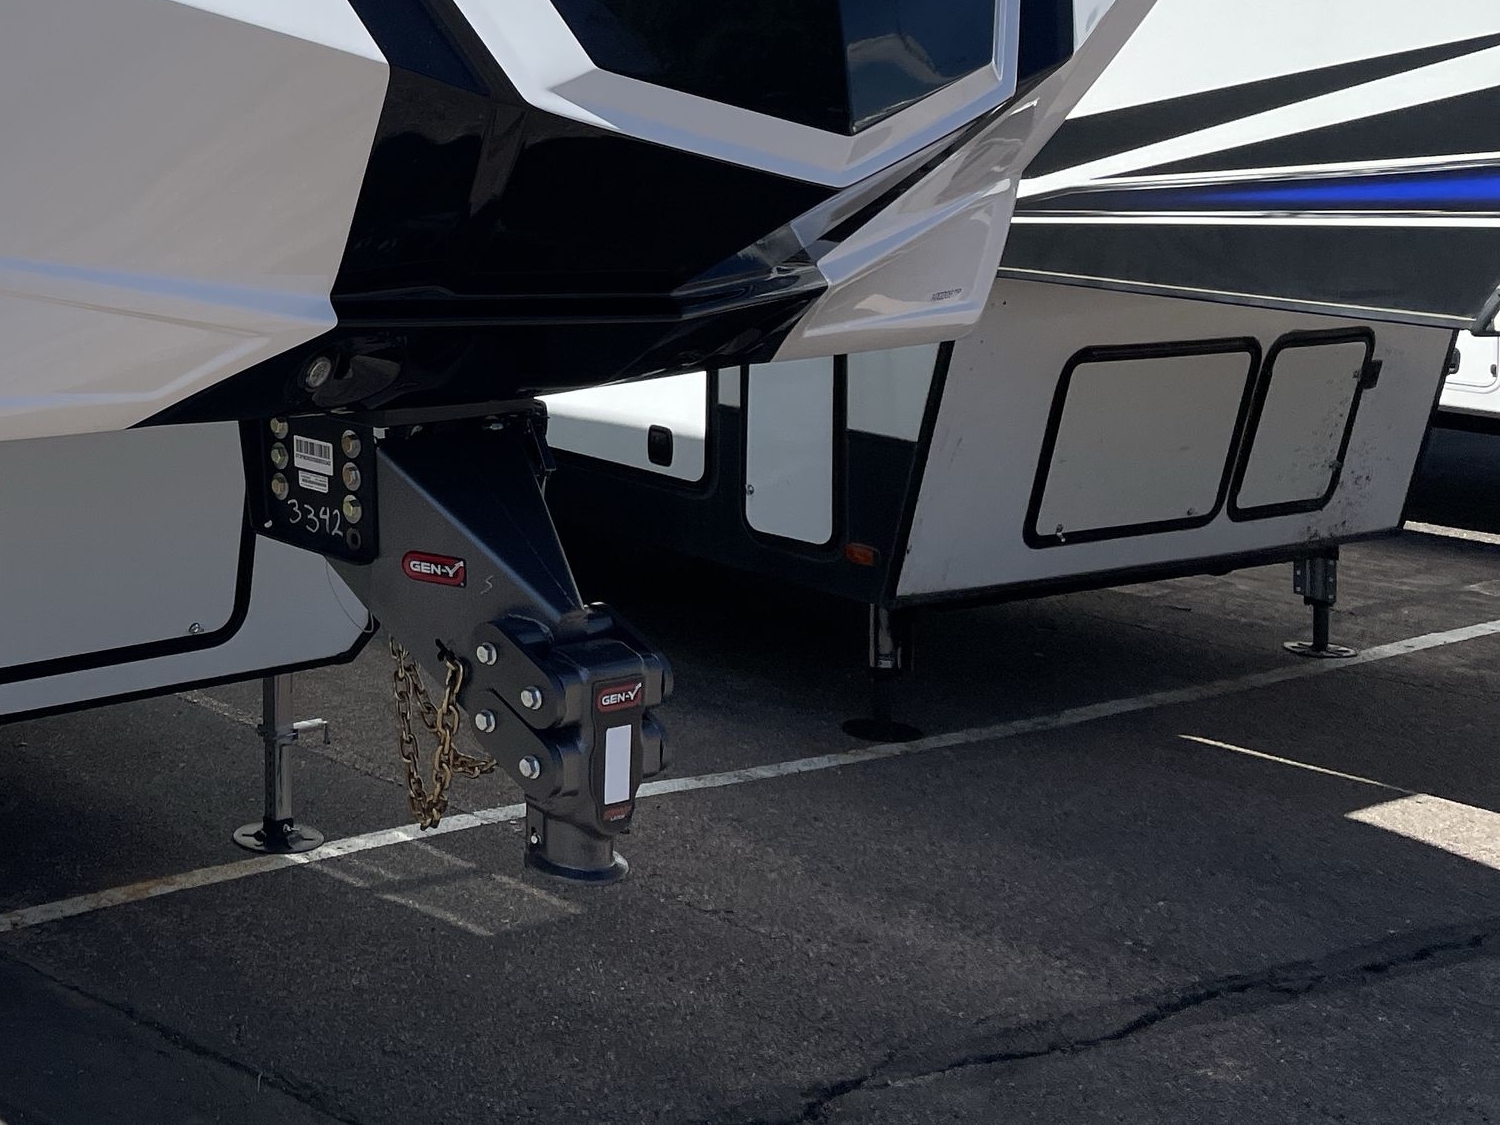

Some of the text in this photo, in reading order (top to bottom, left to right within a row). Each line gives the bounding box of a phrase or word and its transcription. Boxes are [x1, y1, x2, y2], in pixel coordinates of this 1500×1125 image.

[287, 498, 344, 537] 3342
[409, 560, 464, 578] GEN-Y
[601, 682, 642, 706] GEN-Y
